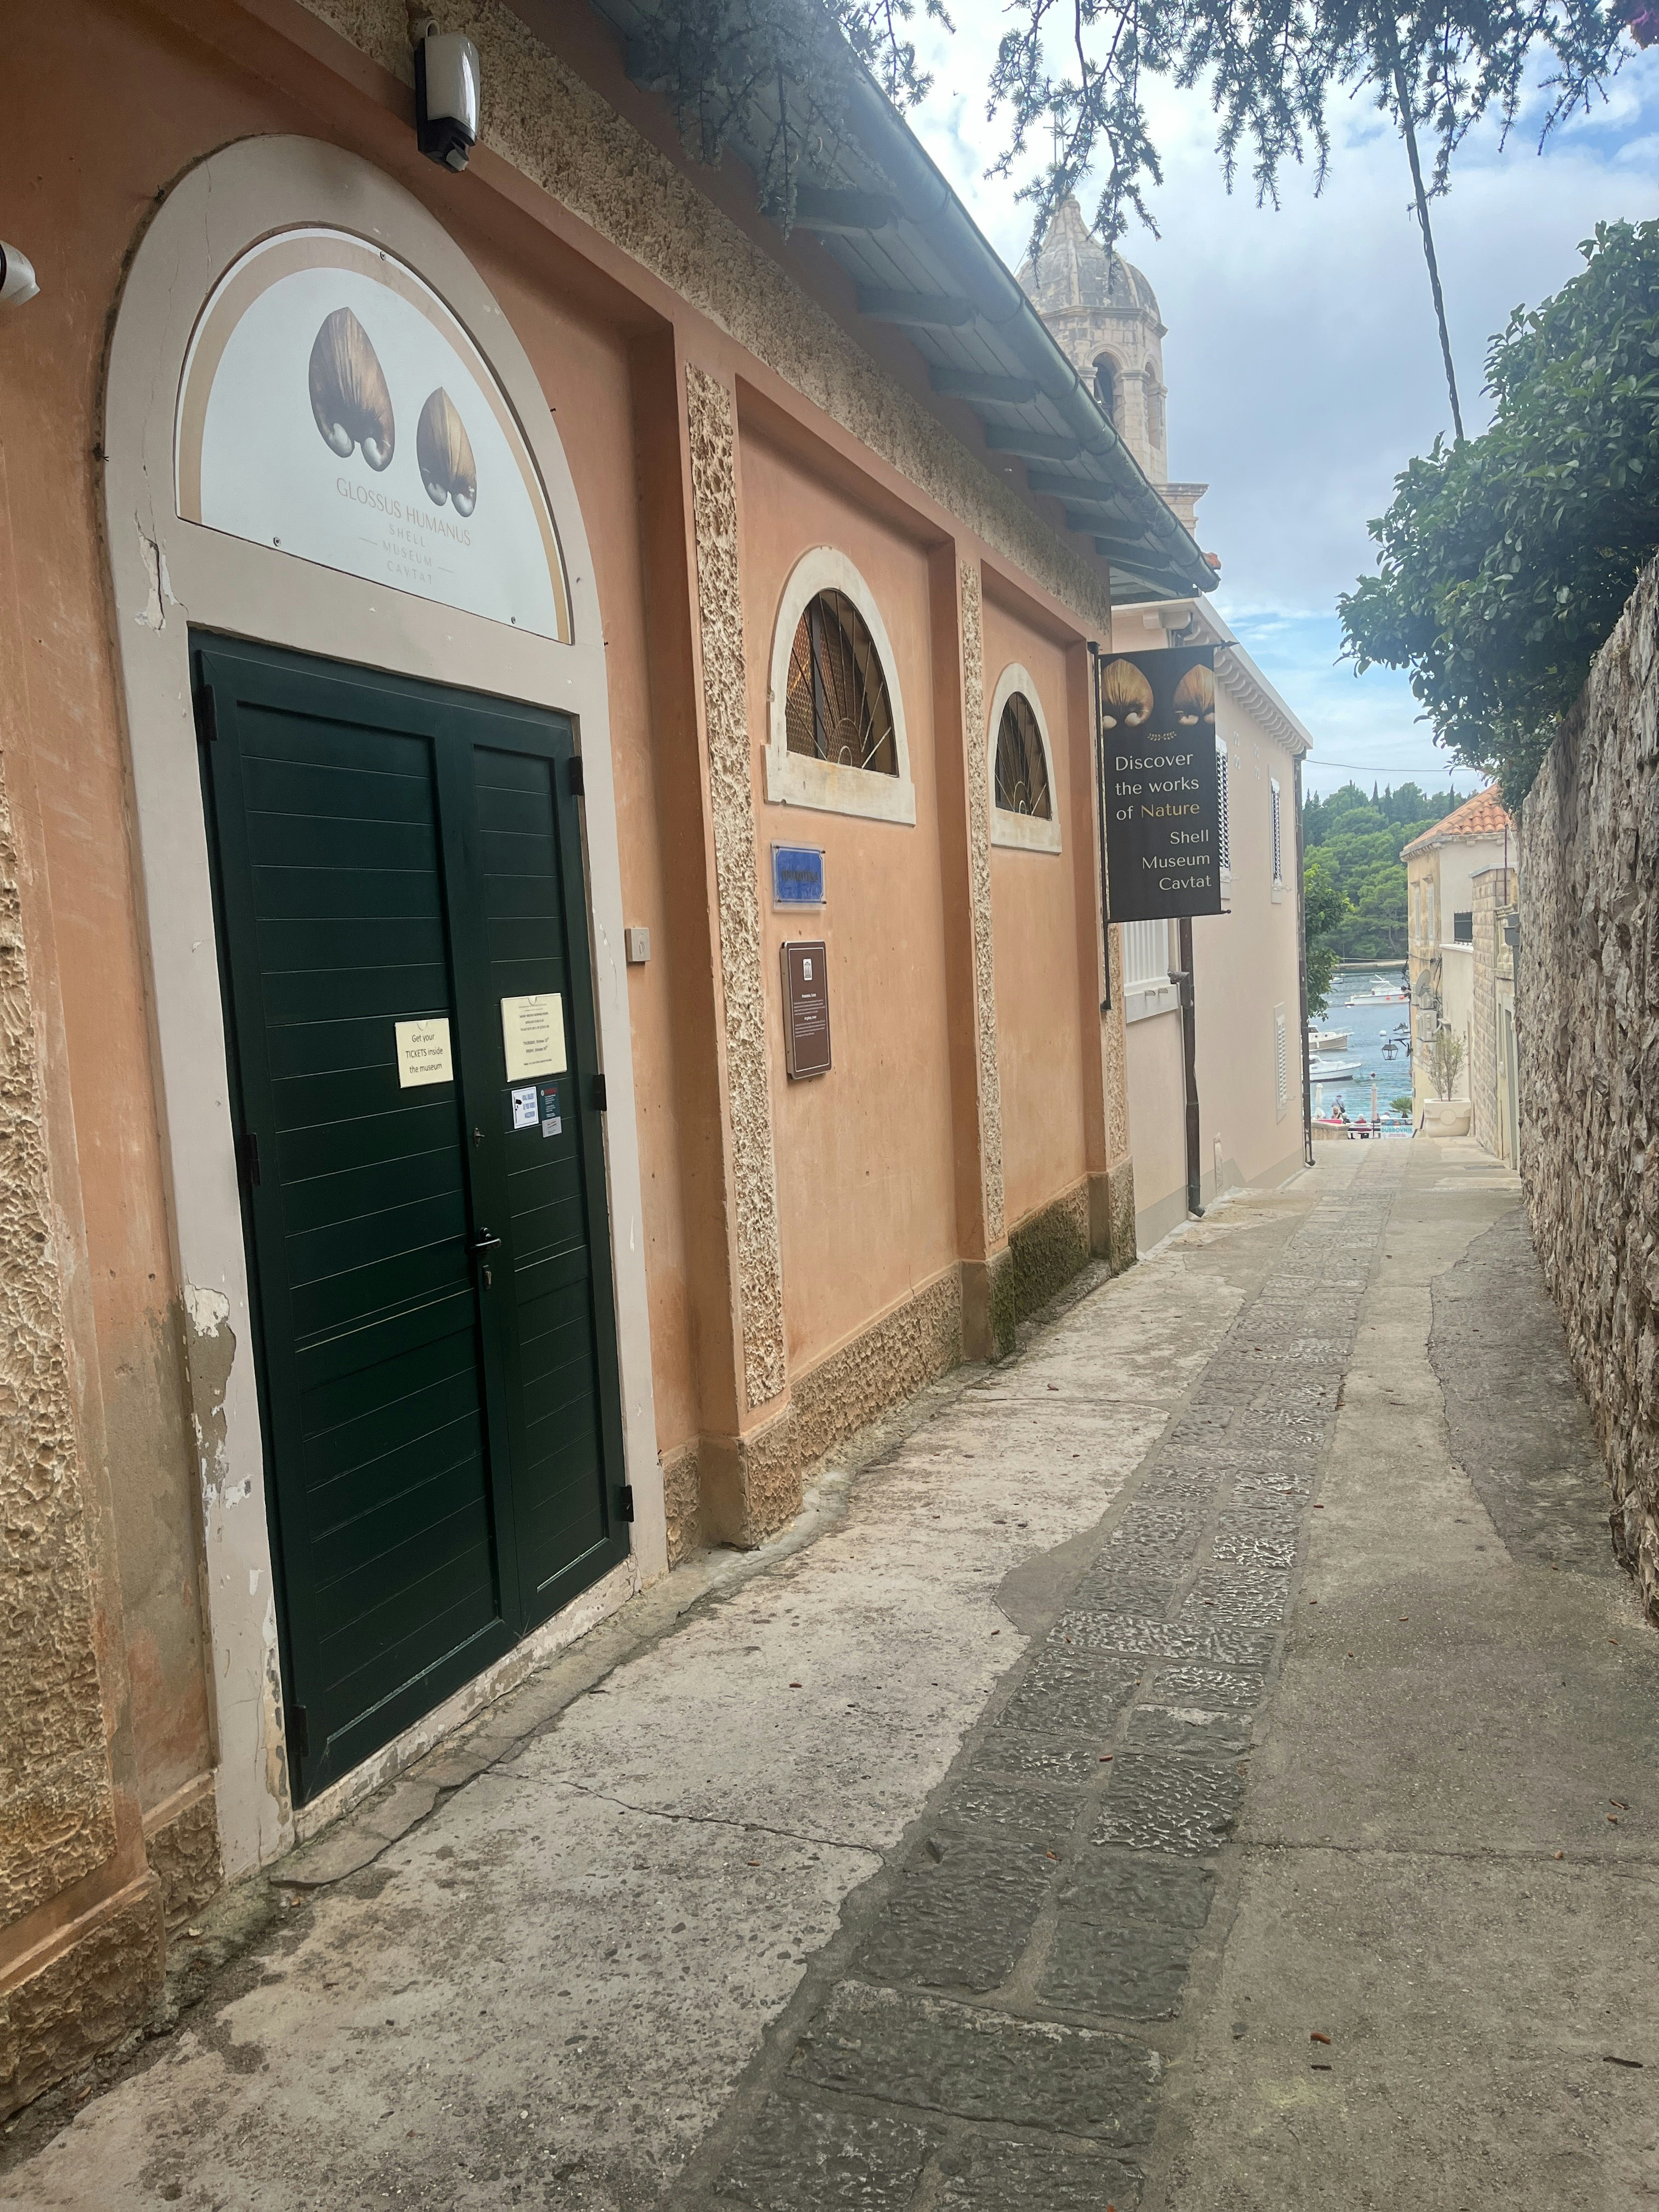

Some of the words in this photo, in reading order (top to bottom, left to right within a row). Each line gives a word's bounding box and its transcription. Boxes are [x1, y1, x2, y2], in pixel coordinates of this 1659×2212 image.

[336, 477, 402, 518] GLOSSUS
[406, 505, 471, 546] HUMANUS
[390, 524, 426, 548] SHELL
[382, 540, 432, 567] MUSEUM
[387, 560, 433, 585] CAVTAT
[1115, 752, 1194, 772] Discover
[1115, 782, 1142, 797] the
[1149, 776, 1200, 793] works
[1116, 805, 1134, 821] of
[1141, 803, 1200, 819] Nature
[1170, 829, 1210, 845] Shell
[1142, 854, 1211, 870] Museum
[1159, 874, 1212, 891] Cavtat
[411, 1034, 422, 1042] Get
[422, 1034, 435, 1043] your
[405, 1048, 427, 1059] TICKETS
[427, 1046, 443, 1056] inside
[409, 1065, 419, 1074] the
[419, 1063, 443, 1073] museum
